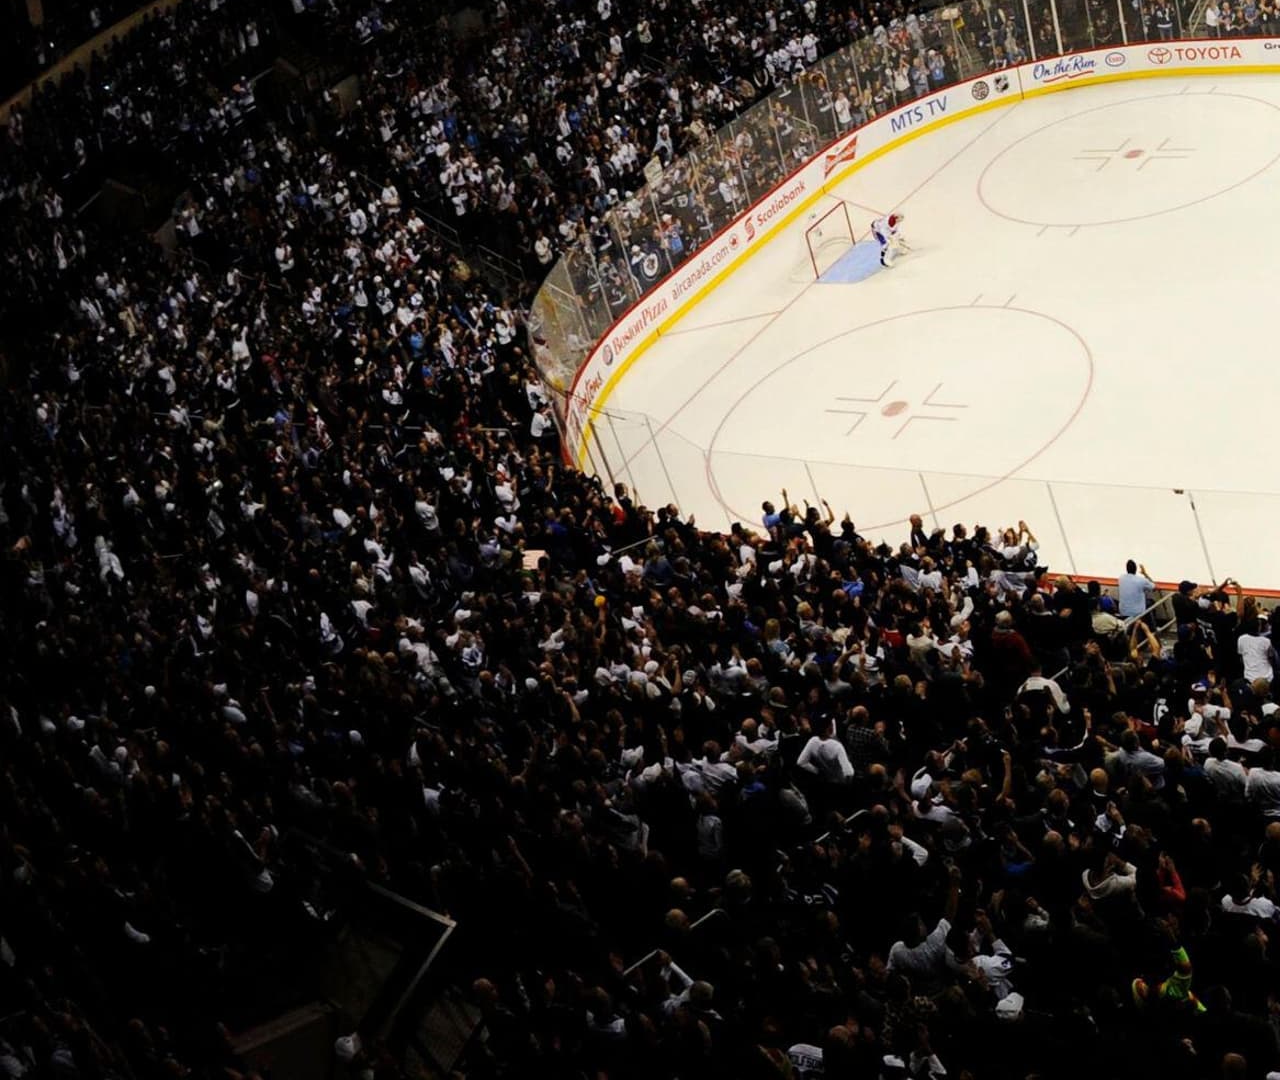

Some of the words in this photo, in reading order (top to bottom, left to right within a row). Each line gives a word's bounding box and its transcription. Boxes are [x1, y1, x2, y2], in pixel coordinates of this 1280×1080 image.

[1033, 62, 1051, 80] On
[1054, 59, 1070, 75] the
[1175, 46, 1241, 61] TOYOTA
[891, 106, 923, 132] MTS
[928, 96, 948, 116] TV
[756, 181, 806, 227] Scotiabank
[671, 245, 730, 300] aircanada.com
